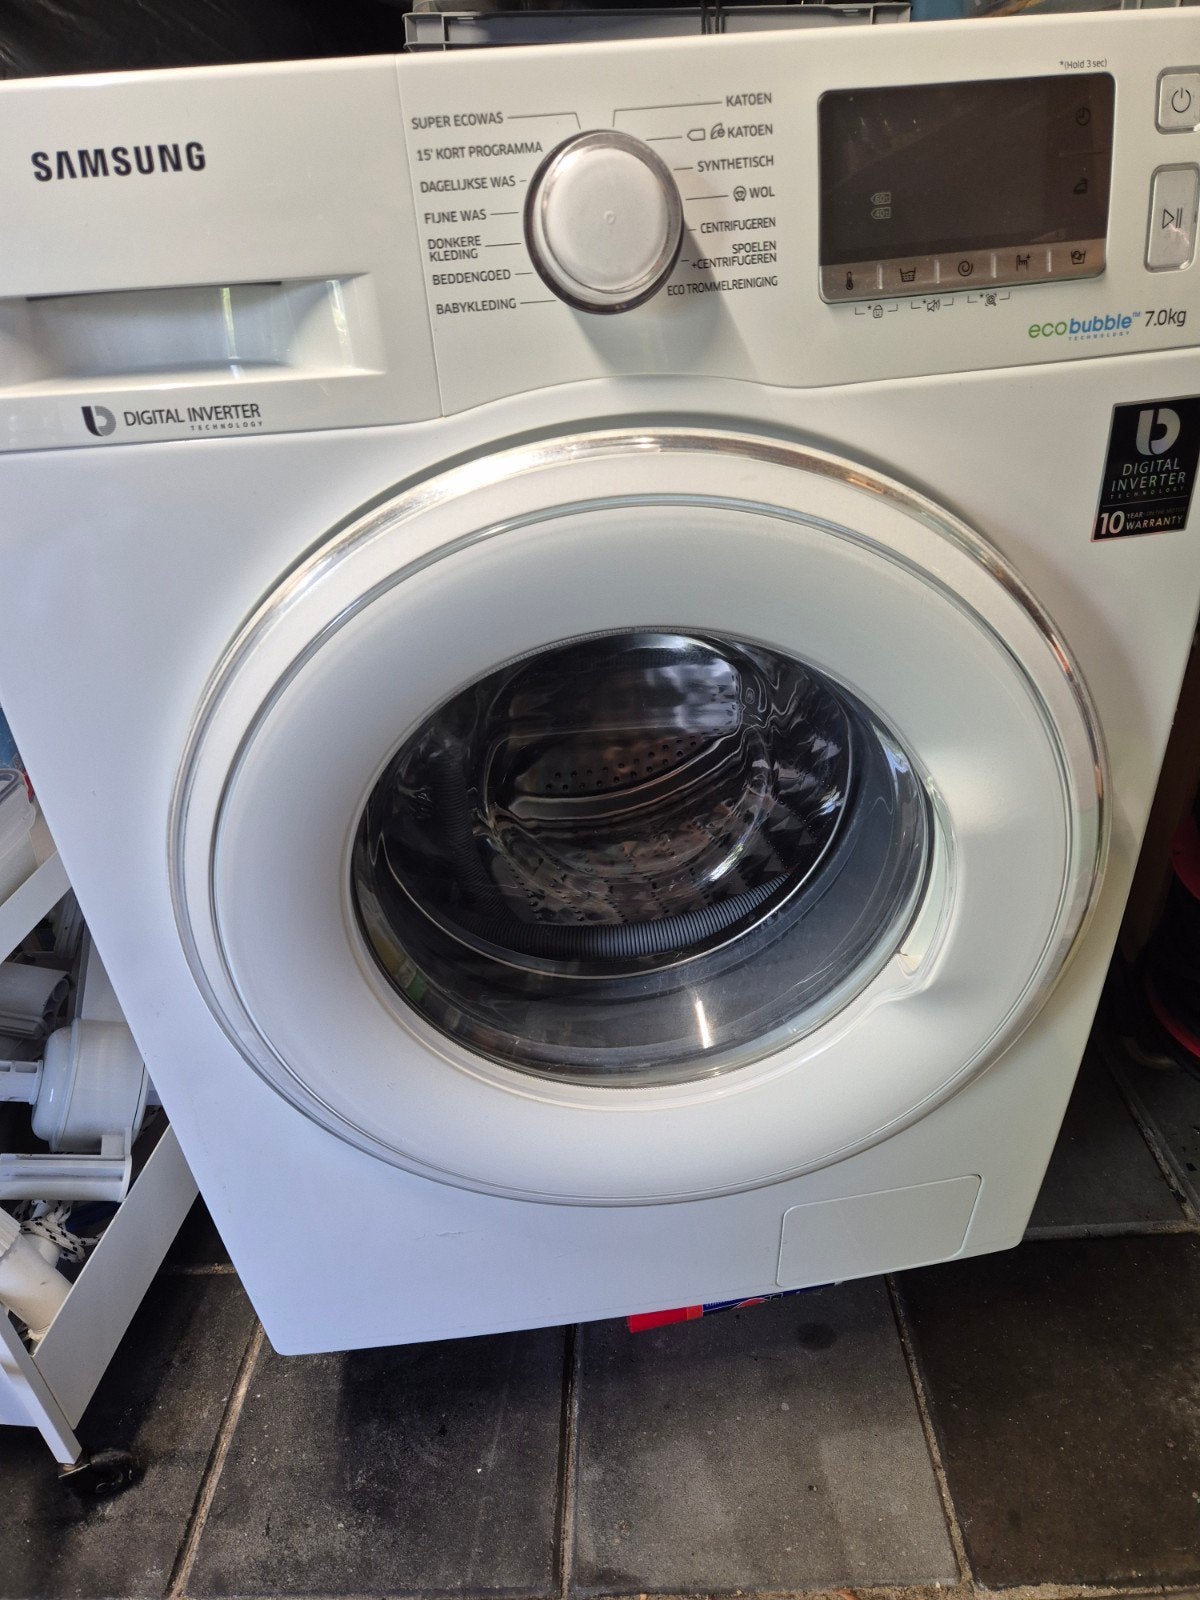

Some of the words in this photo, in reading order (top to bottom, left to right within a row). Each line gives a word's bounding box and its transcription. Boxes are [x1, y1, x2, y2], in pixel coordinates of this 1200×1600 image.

[1086, 59, 1091, 68] 3
[1092, 58, 1108, 68] sec)
[726, 93, 772, 108] KATOEN
[411, 115, 452, 130] SUPER
[454, 111, 504, 127] ECOWAS
[727, 124, 773, 139] KATOEN
[416, 148, 433, 161] 15'
[435, 146, 466, 160] KORT
[469, 142, 543, 157] PROGRAMMA
[31, 141, 207, 182] SAMSUNG
[697, 155, 774, 172] SYNTHETISCH
[420, 178, 488, 194] DAGELIJKSE
[491, 175, 515, 189] WAS
[750, 186, 774, 199] WOL
[424, 211, 458, 224] FIJNE
[460, 209, 487, 222] WAS
[700, 217, 776, 234] CENTRIFUGEREN
[428, 236, 481, 250] DONKERE
[732, 241, 777, 255] SPOELEN
[429, 248, 478, 262] KLEDING
[691, 253, 777, 270] +CENTRIFUGEREN
[432, 269, 511, 286] BEDDENGOED
[667, 283, 685, 296] ECO
[686, 276, 778, 294] TROMMELREINIGING
[436, 298, 516, 314] BABYKLEDING
[1144, 308, 1187, 327] 7.0kg
[1068, 331, 1130, 341] TECHNOLOGY
[123, 406, 185, 427] DIGITAL
[187, 403, 261, 422] INVERTER
[190, 421, 264, 431] TECHNOLOGY
[1122, 457, 1180, 476] DIGITAL
[1112, 471, 1186, 492] INVERTER
[1100, 510, 1125, 535] 10
[1126, 515, 1184, 530] WARRANTY
